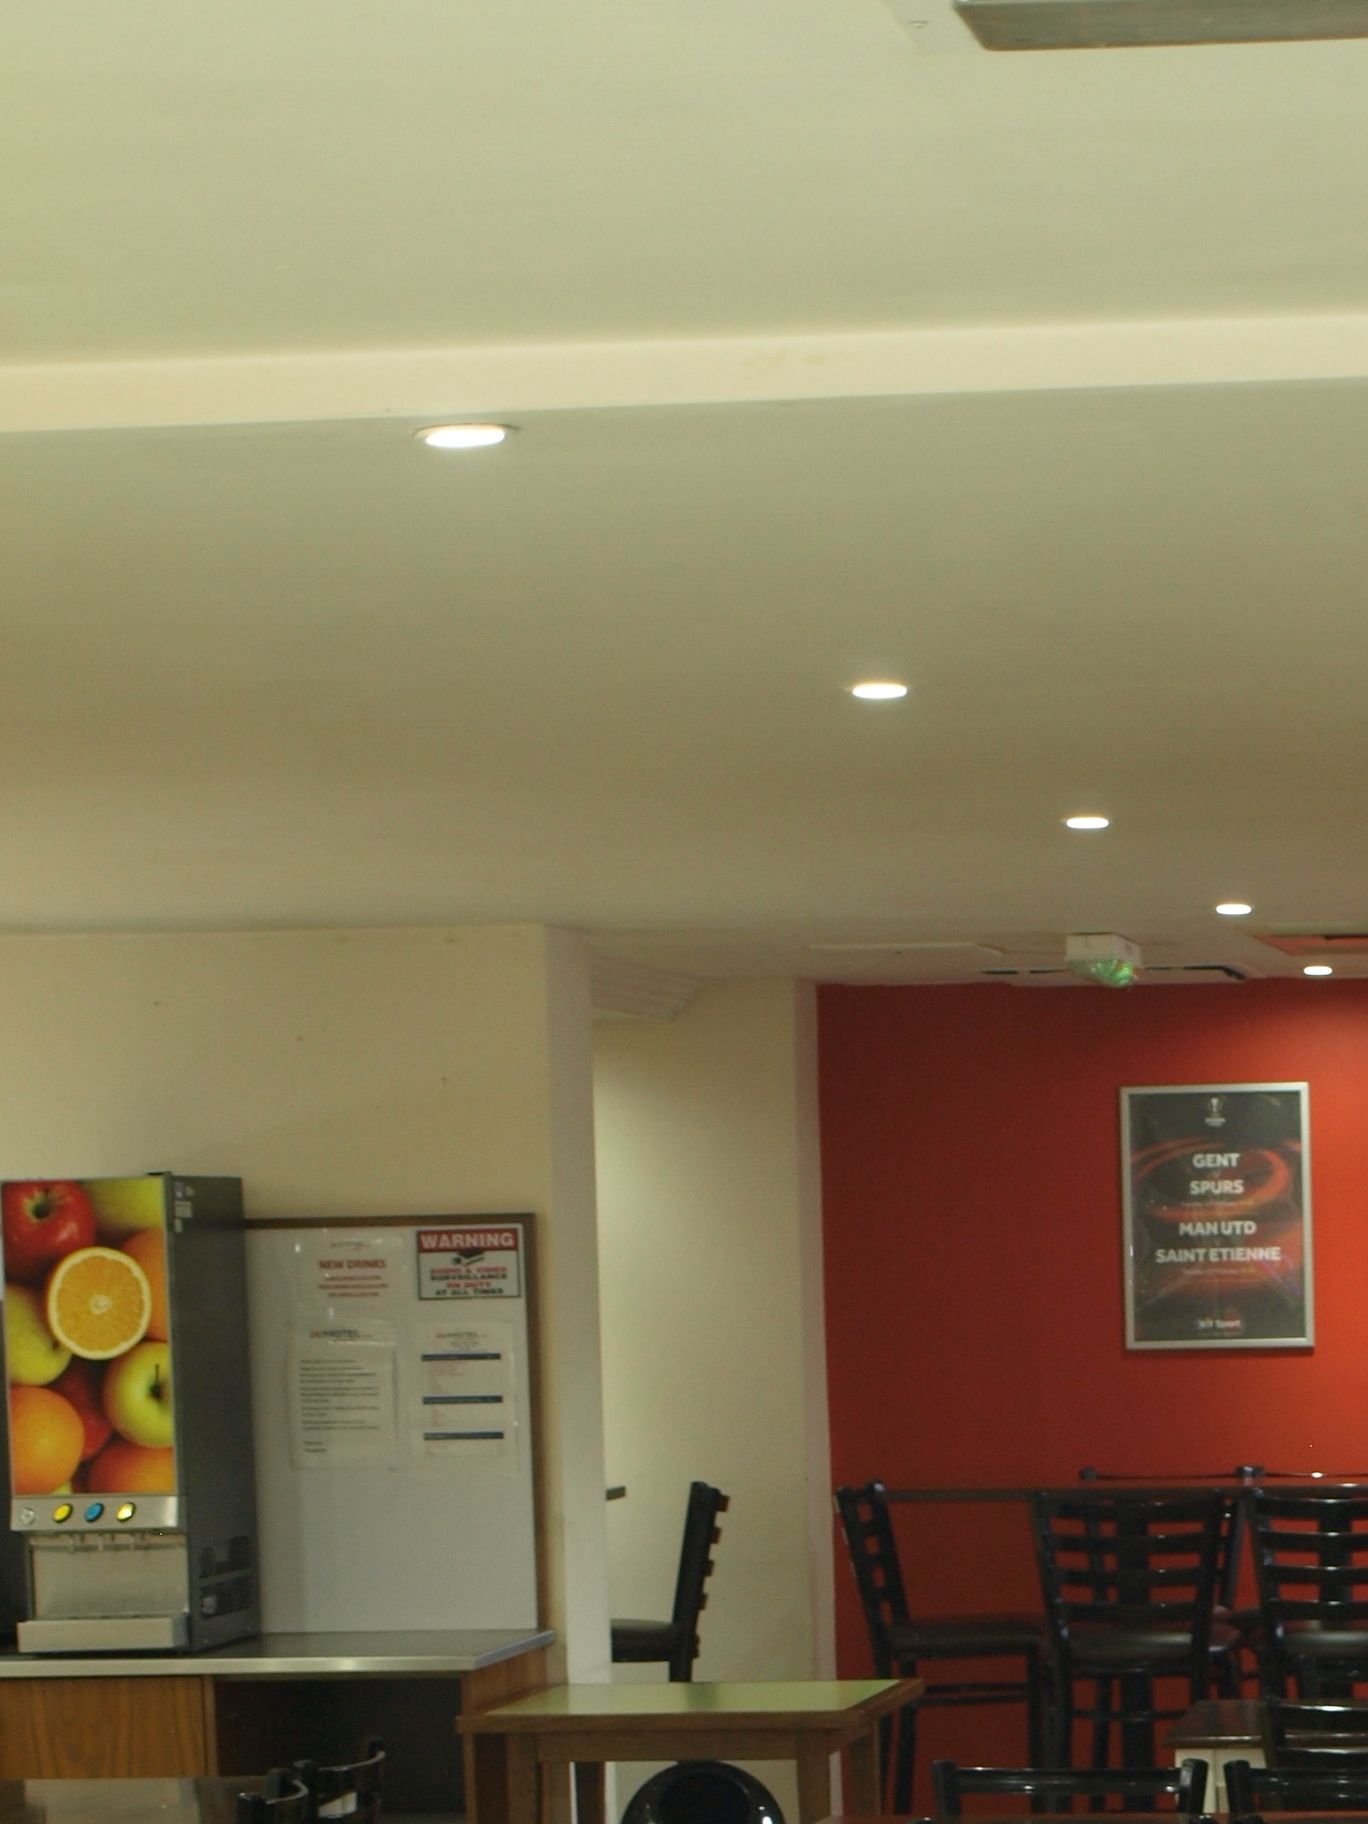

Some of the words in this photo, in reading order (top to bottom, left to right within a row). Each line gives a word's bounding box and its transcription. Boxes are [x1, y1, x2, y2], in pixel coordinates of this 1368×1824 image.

[1192, 1152, 1240, 1168] GENT
[1190, 1179, 1244, 1195] SPURS
[1179, 1221, 1218, 1235] MAN
[1220, 1220, 1257, 1235] UTD
[420, 1231, 514, 1250] WARNING
[1156, 1248, 1206, 1263] SAINT
[1208, 1246, 1281, 1262] ETIENNE
